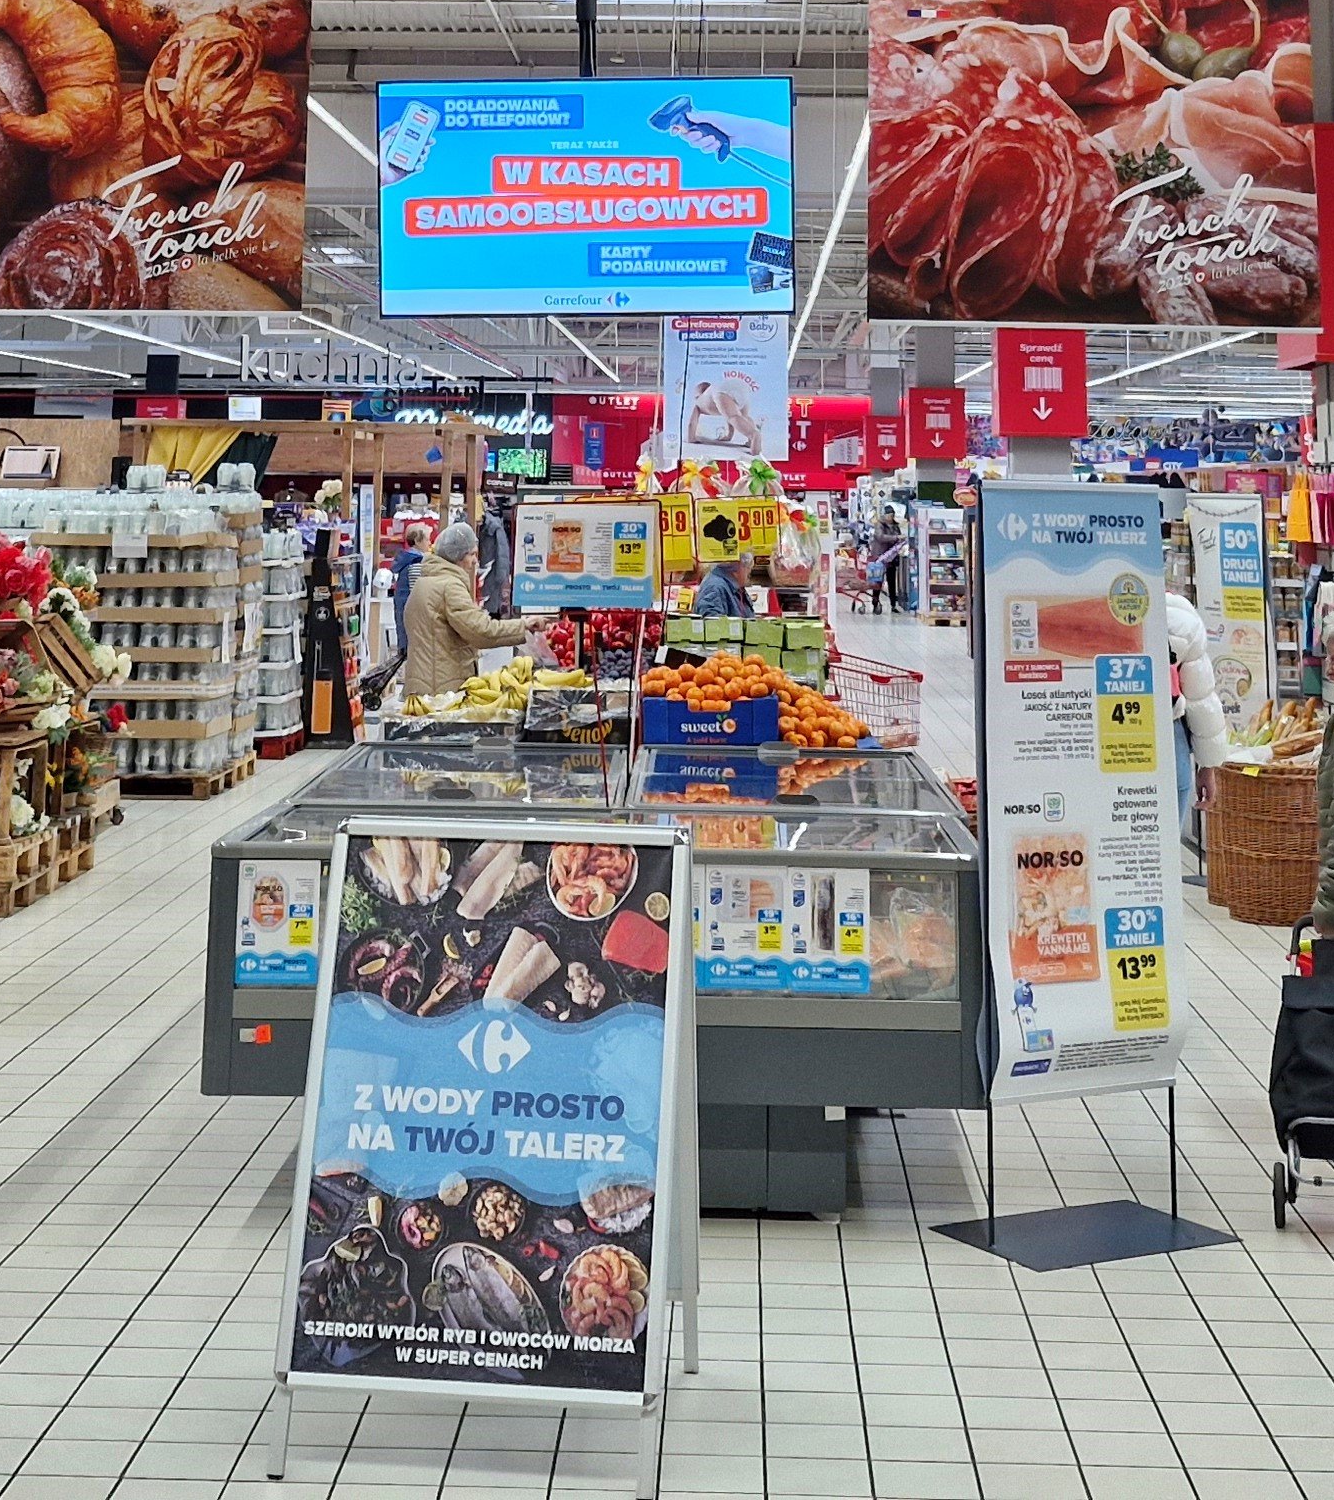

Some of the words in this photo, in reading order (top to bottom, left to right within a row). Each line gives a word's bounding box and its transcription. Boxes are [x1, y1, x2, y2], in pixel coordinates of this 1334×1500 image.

[444, 114, 469, 127] DO
[500, 160, 533, 186] W
[540, 161, 669, 186] KASACH
[100, 155, 246, 241] French
[415, 194, 757, 230] SAMOOBSŁUGOWYCH
[1109, 167, 1254, 252] French
[133, 189, 266, 261] touch
[1147, 204, 1279, 275] touch
[601, 245, 652, 259] KARTY
[143, 260, 178, 281] 2025
[544, 295, 602, 306] Carrefour
[1020, 343, 1063, 354] Sprawdź
[240, 333, 424, 386] kuchnia
[1030, 355, 1054, 364] cenę
[1032, 514, 1042, 527] Z
[1043, 514, 1086, 528] WODY
[1089, 515, 1144, 528] PROSTO
[1032, 531, 1052, 544] NA
[1056, 528, 1093, 544] TWÓJ
[1097, 531, 1147, 544] TALERZ
[1224, 529, 1256, 549] 50%
[1223, 558, 1257, 570] DRUGI
[1223, 570, 1259, 583] TANIEJ
[1109, 658, 1146, 679] 37%
[1104, 681, 1145, 693] TANIEJ
[1021, 690, 1047, 700] Łosoś
[1049, 688, 1092, 701] atlantycki
[1061, 702, 1092, 711] NATURY
[1046, 713, 1093, 722] CARREFOUR
[680, 719, 721, 734] sweet
[1117, 785, 1157, 795] Krewetki
[1113, 799, 1158, 811] gotowane
[1112, 813, 1127, 822] bez
[1130, 812, 1158, 824] głowy
[1130, 825, 1159, 833] NORSO
[1117, 909, 1157, 931] 30%
[1038, 932, 1087, 945] KREWETKI
[1114, 932, 1155, 946] TANIEJ
[355, 1085, 374, 1111] Z
[381, 1086, 484, 1115] WODY
[491, 1091, 625, 1121] PROSTO
[347, 1123, 395, 1151] NA
[404, 1121, 495, 1156] TWÓJ
[504, 1131, 626, 1162] TALERZ
[304, 1321, 374, 1338] SZEROKI
[376, 1323, 440, 1342] WYBÓR
[443, 1327, 476, 1344] RYB
[480, 1330, 486, 1345] I
[489, 1329, 570, 1350] OWOCÓW
[573, 1335, 635, 1354] MORZA
[395, 1346, 413, 1362] W
[415, 1348, 471, 1366] SUPER
[474, 1350, 544, 1370] CENACH
